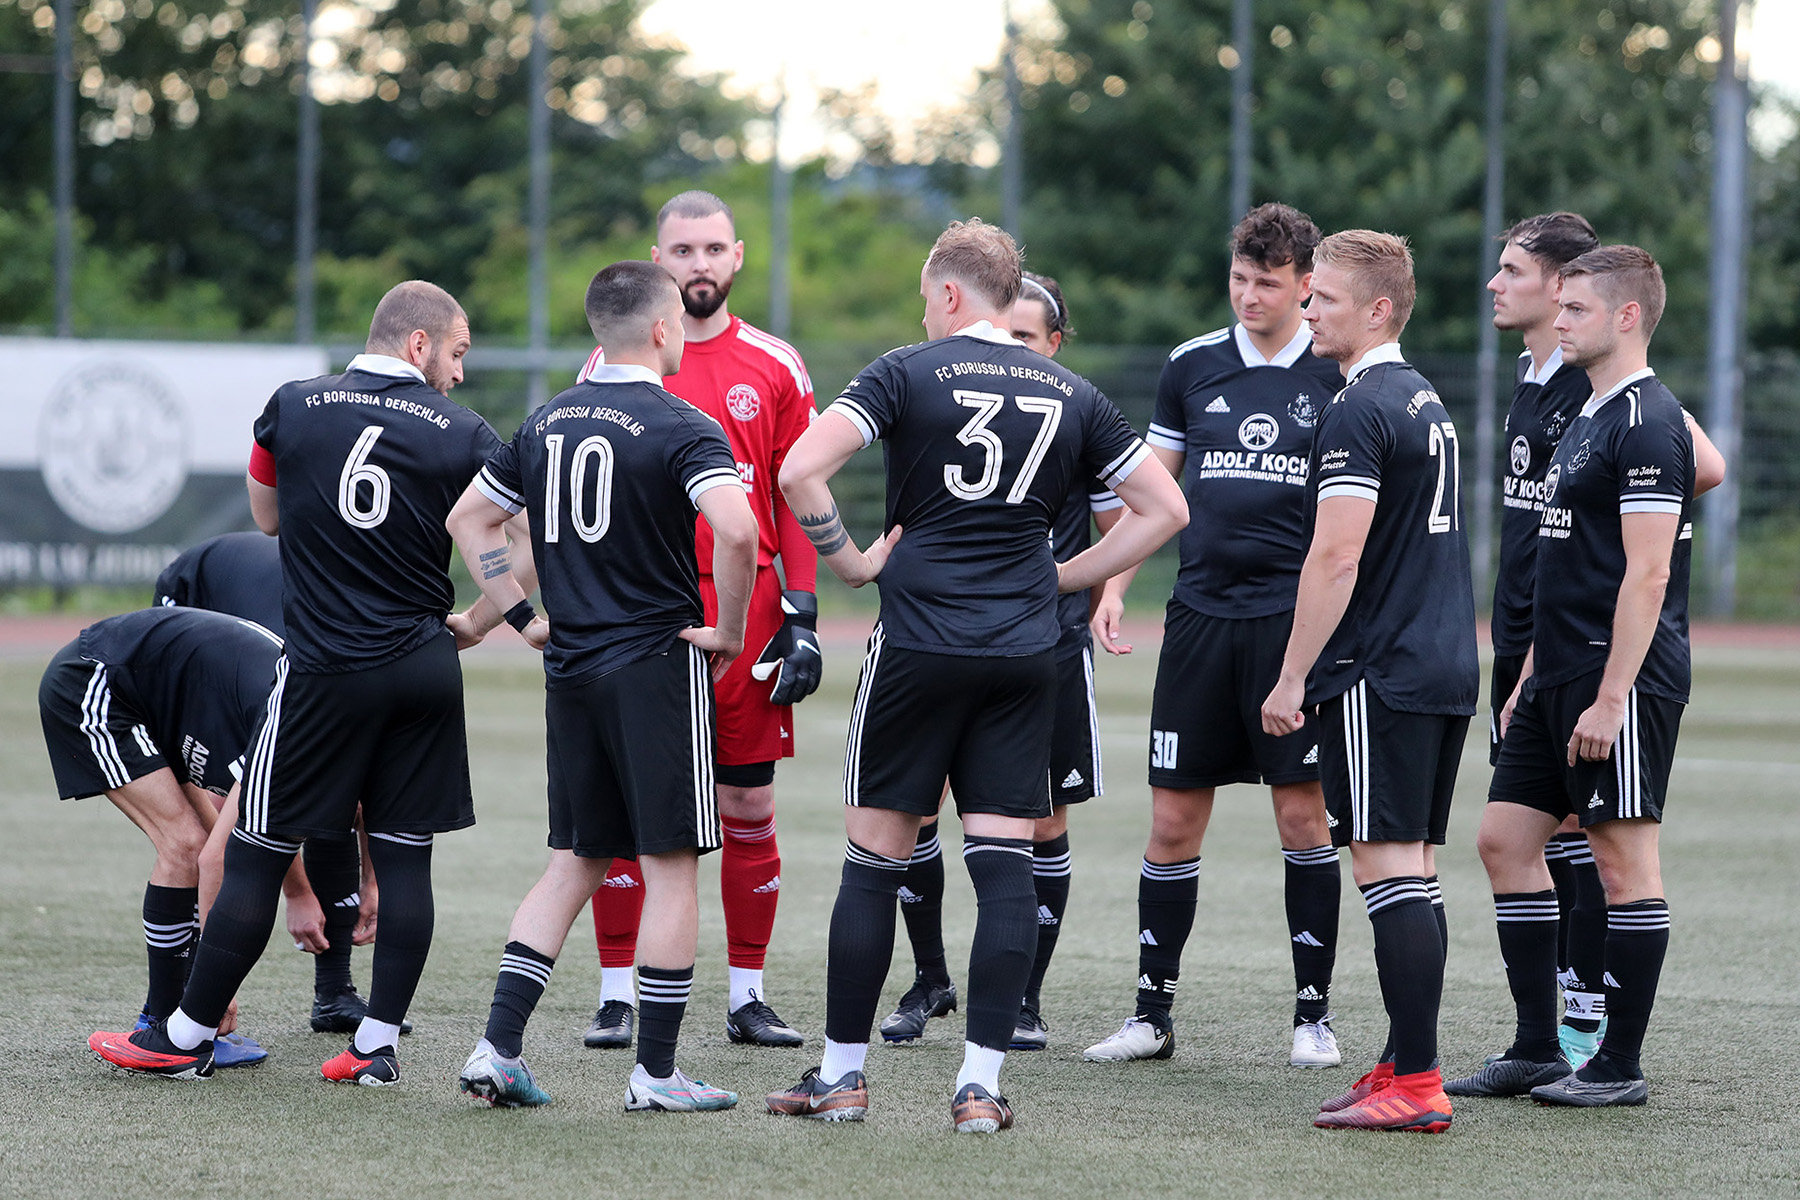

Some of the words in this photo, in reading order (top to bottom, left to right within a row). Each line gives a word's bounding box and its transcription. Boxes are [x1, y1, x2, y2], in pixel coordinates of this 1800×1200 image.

[935, 365, 952, 382] FC
[952, 362, 1007, 376] BORUSSIA
[1010, 366, 1073, 397] DERSCHLAG
[306, 394, 320, 408] FC
[323, 390, 380, 406] BORUSSIA
[385, 397, 450, 429] DERSCHLAG
[535, 420, 545, 436] FC
[591, 407, 645, 436] DERSCHLAG
[944, 389, 1063, 504] 37
[1201, 451, 1257, 469] ADOLF
[338, 425, 391, 529] 6
[545, 434, 614, 543] 10
[1200, 469, 1284, 483] BAUUNTERNEHMUNG
[1518, 479, 1545, 501] KOC
[1152, 730, 1179, 769] 30
